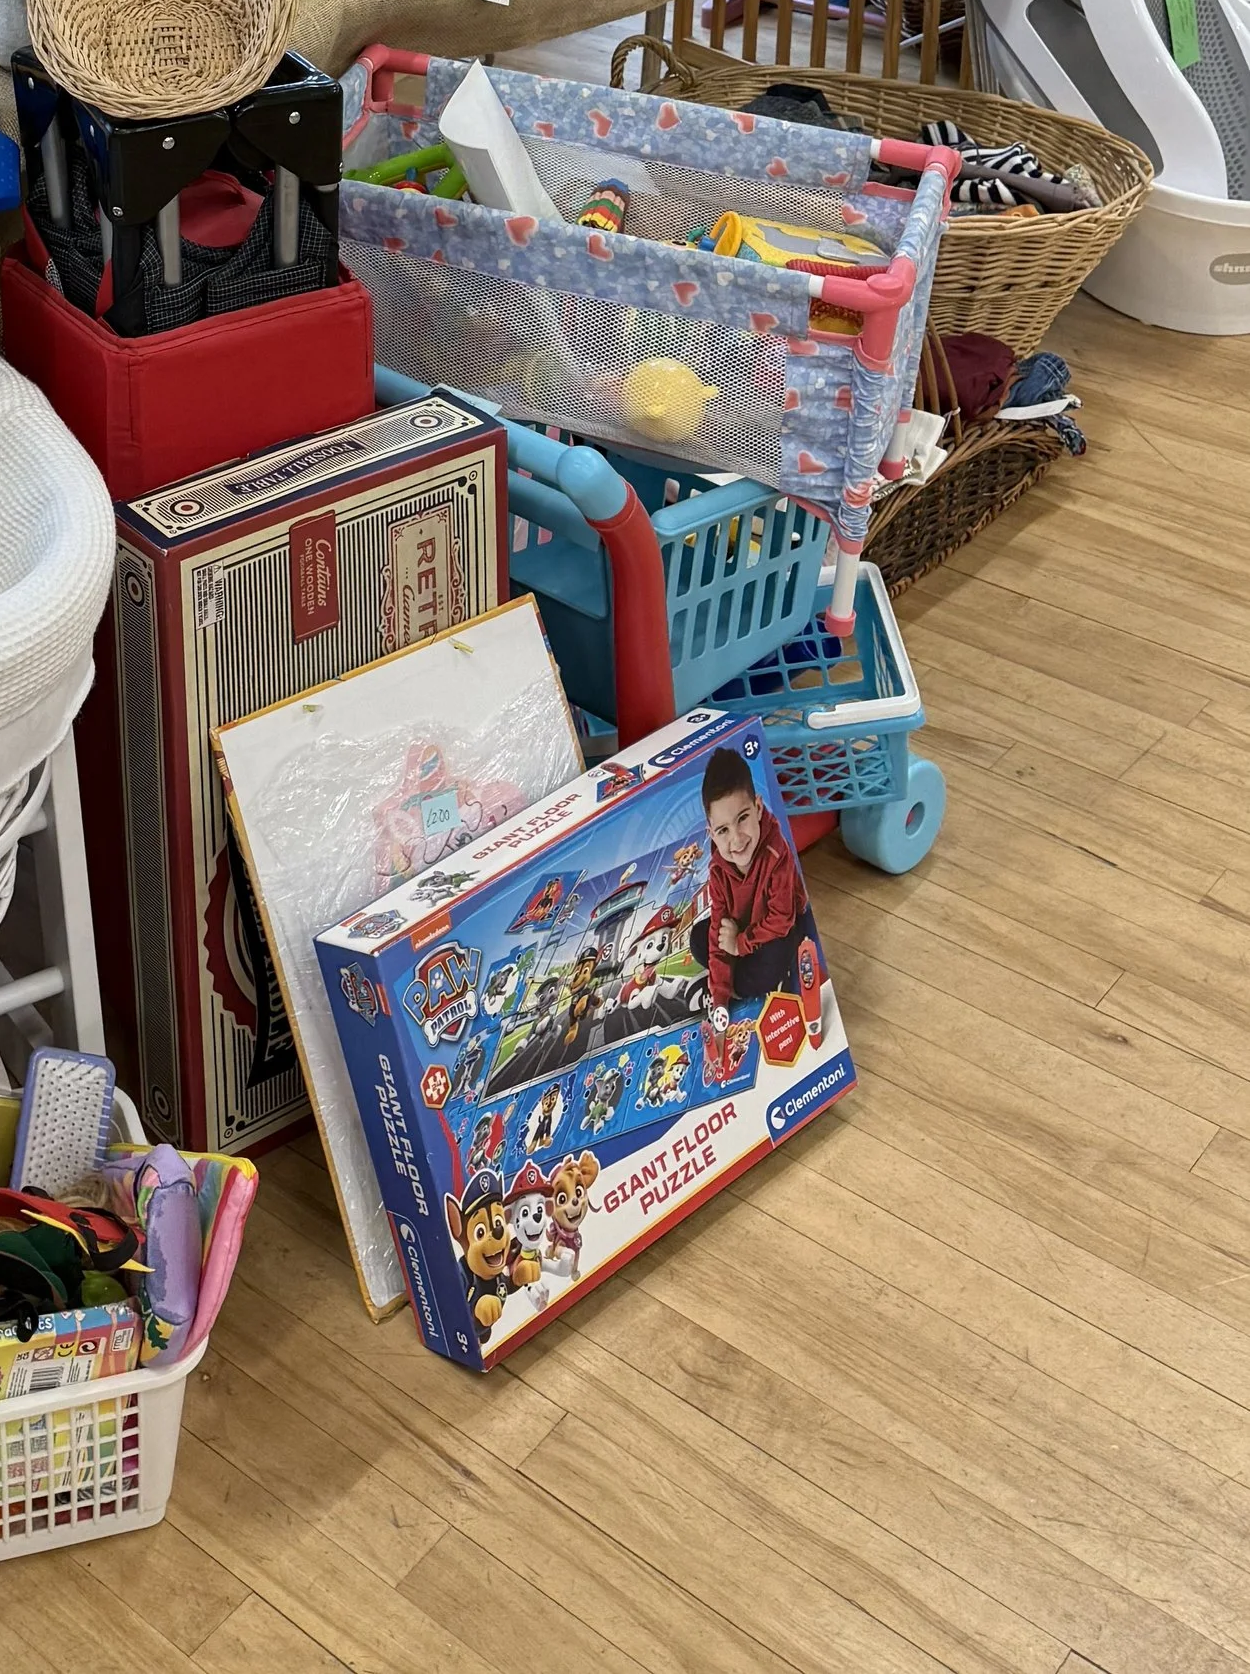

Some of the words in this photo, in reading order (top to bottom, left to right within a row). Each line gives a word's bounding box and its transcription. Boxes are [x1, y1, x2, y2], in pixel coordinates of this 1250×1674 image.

[283, 441, 355, 476] FOOSBALL
[235, 471, 287, 493] TABLE
[304, 537, 313, 562] ONE
[305, 564, 315, 616] WOODEN
[315, 538, 332, 607] Contains
[416, 537, 438, 637] RET
[670, 718, 736, 756] Clementoni
[744, 740, 759, 757] 3+
[472, 826, 527, 860] GIANT
[526, 793, 582, 826] FLOOR
[508, 810, 574, 848] PUZZLE
[415, 924, 450, 949] nickelodeon
[403, 948, 482, 1026] PAW
[430, 998, 472, 1036] PATROL
[765, 1015, 800, 1043] interactive
[769, 1009, 786, 1024] With
[785, 1063, 847, 1116] Clementoni
[375, 1085, 408, 1178] PUZZLE
[378, 1053, 407, 1133] GIANT
[400, 1136, 430, 1217] FLOOR
[603, 1150, 668, 1214] GIANT
[672, 1102, 737, 1162] FLOOR
[639, 1144, 717, 1215] PUZZLE
[407, 1245, 439, 1338] Clementoni
[456, 1331, 468, 1354] 3+
